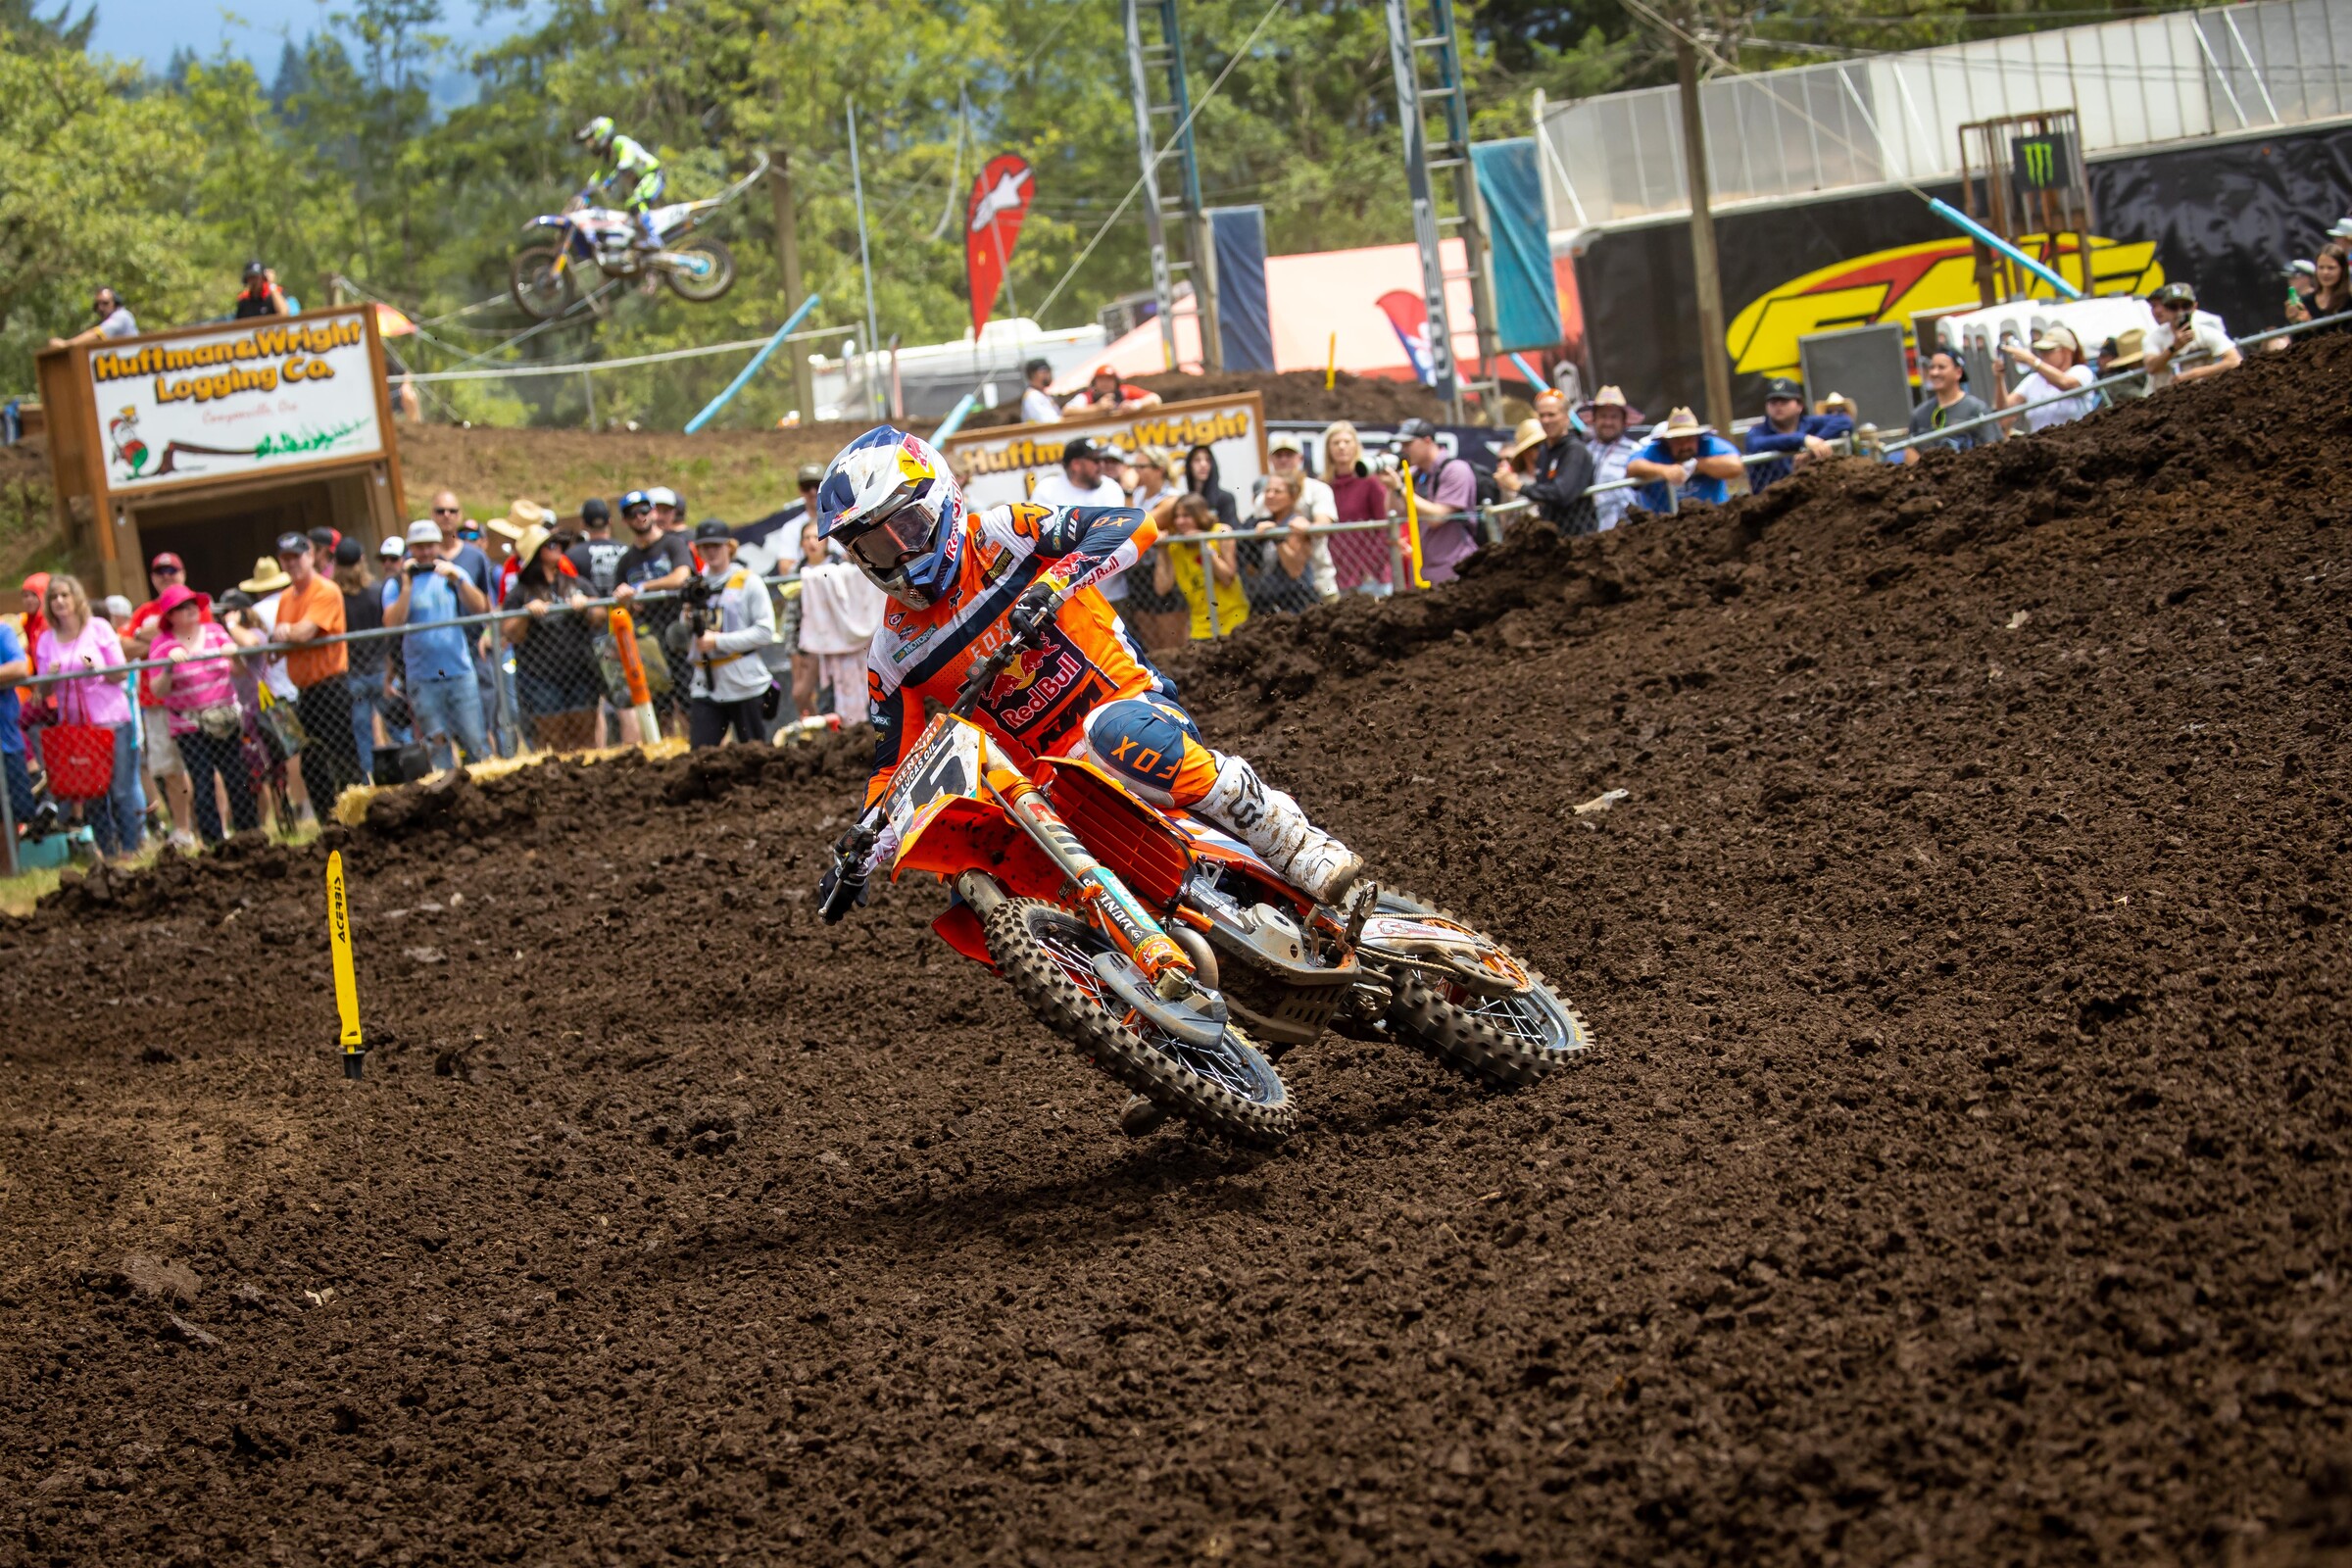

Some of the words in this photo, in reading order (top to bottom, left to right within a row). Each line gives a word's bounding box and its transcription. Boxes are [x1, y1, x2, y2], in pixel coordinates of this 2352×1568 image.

[155, 366, 278, 403] Logging
[281, 355, 334, 382] Co.
[1097, 555, 1120, 580] Bull
[1001, 686, 1049, 729] Red
[1035, 651, 1082, 702] Bull
[901, 759, 924, 794] LUCAS
[924, 742, 939, 760] OIL
[1110, 735, 1183, 780] FOX
[1083, 878, 1135, 930] DUNLP
